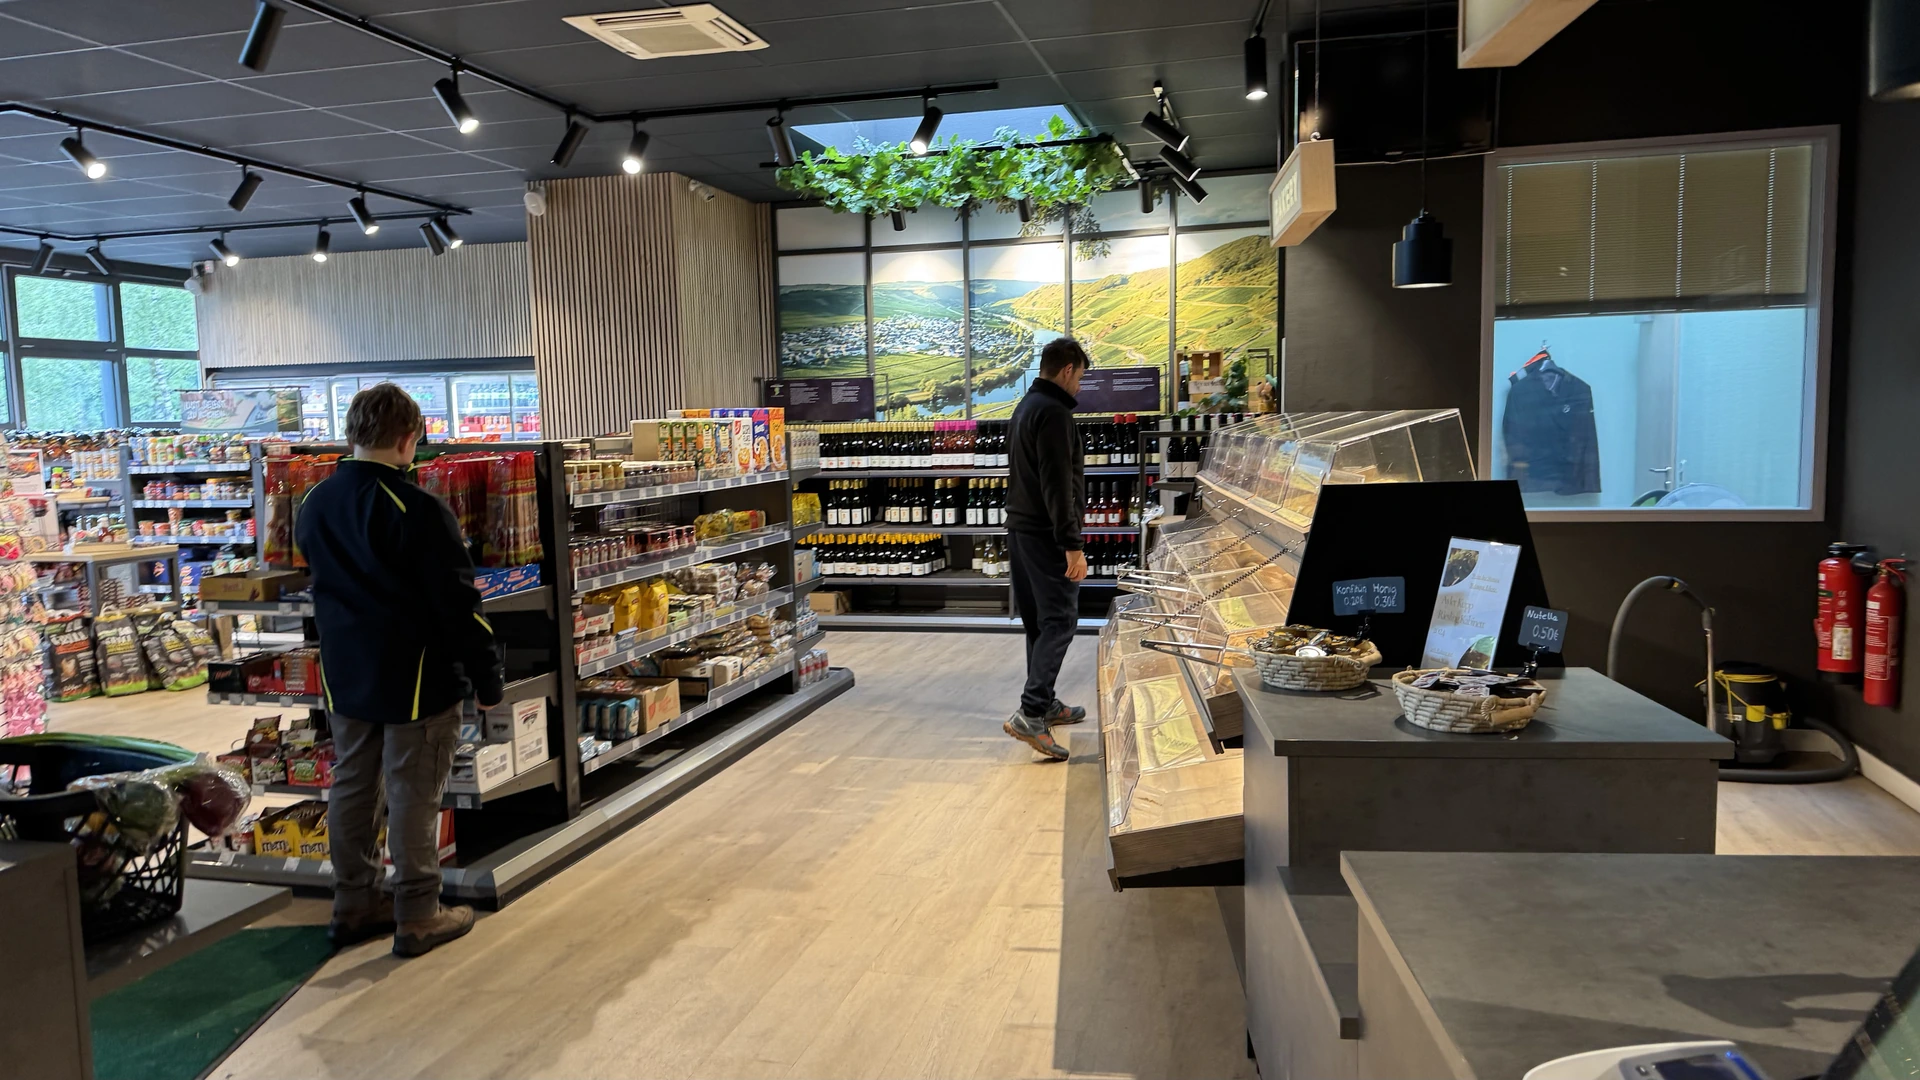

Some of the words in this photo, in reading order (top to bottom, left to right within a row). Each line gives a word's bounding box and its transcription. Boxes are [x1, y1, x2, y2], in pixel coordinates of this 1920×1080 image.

[1372, 583, 1397, 599] Honig
[1374, 595, 1397, 608] 0.30€
[1526, 609, 1559, 622] Nutella
[1532, 624, 1560, 641] 0.50€
